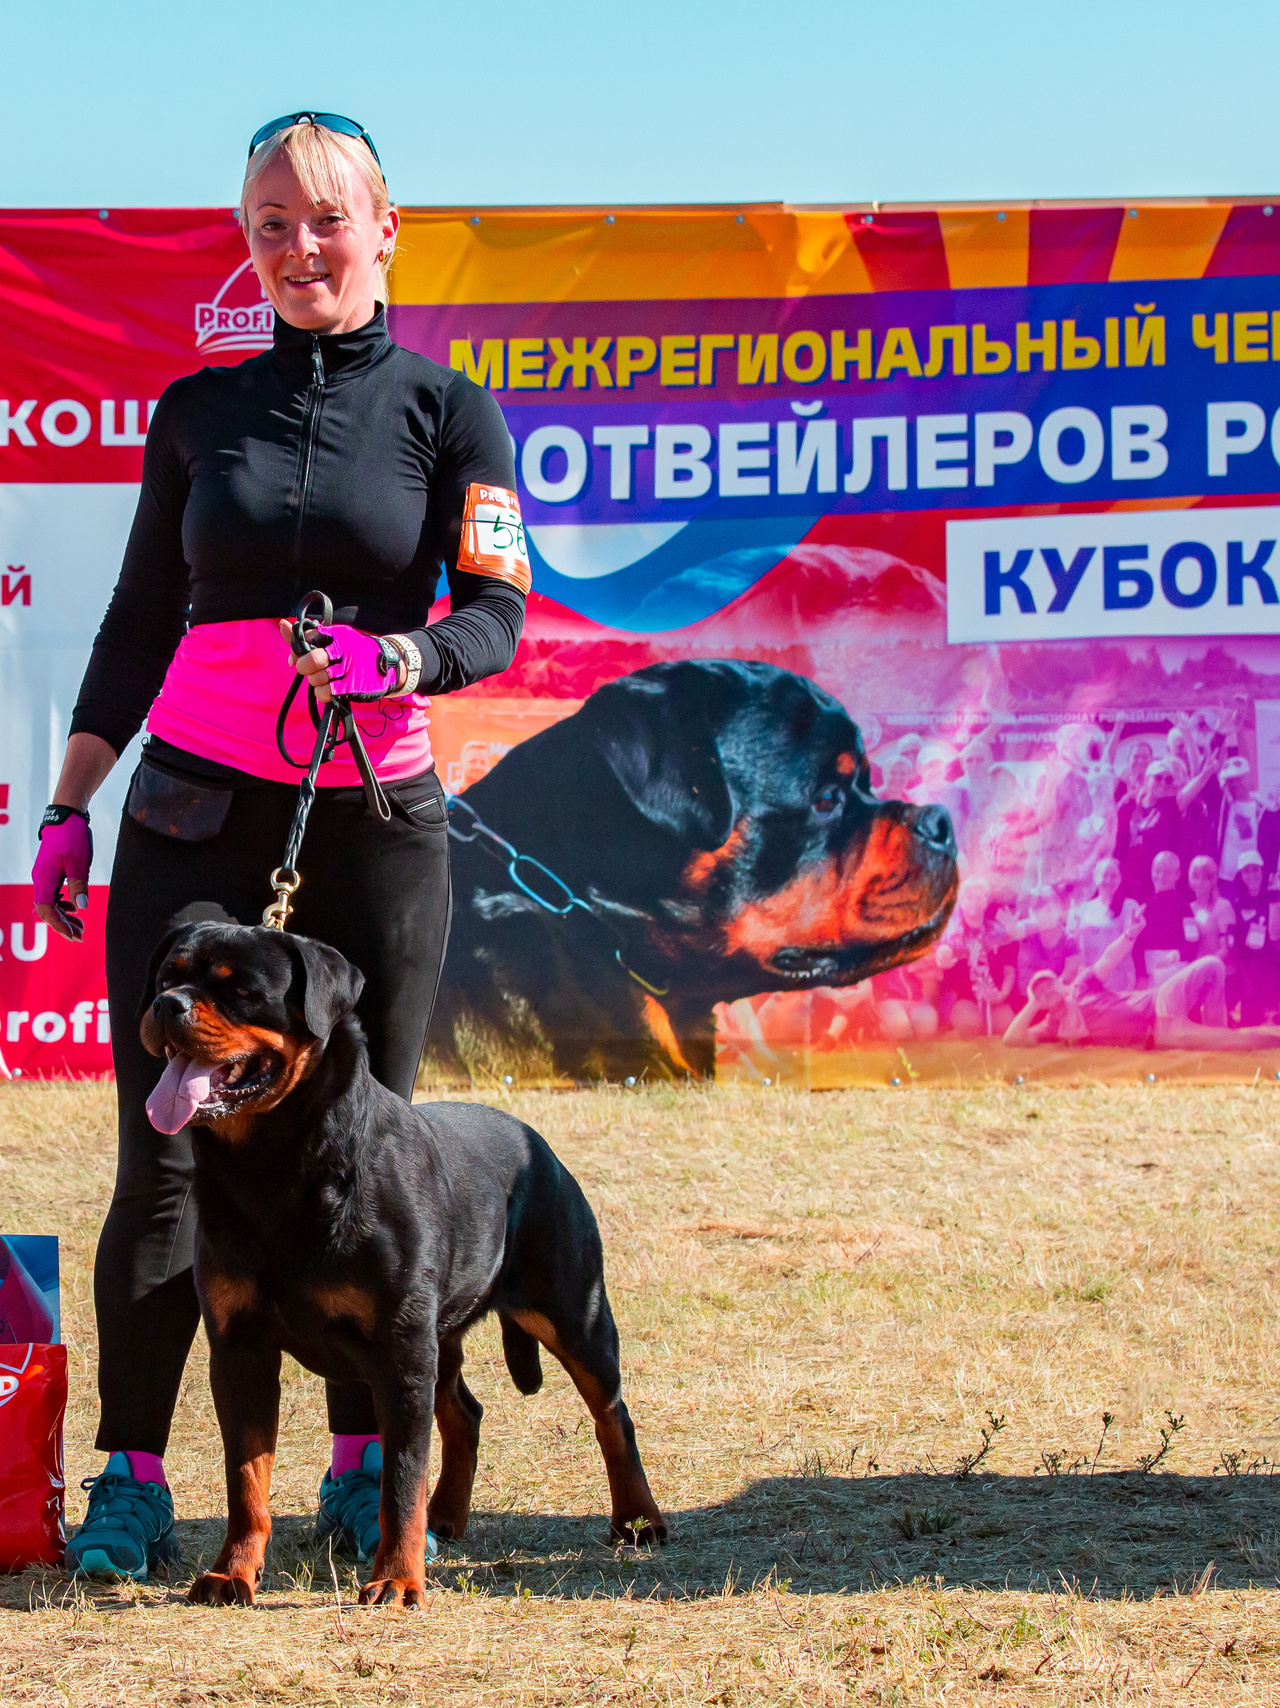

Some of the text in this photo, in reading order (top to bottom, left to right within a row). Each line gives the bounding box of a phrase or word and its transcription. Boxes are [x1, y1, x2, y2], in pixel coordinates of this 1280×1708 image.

[195, 302, 276, 333] PROFI
[449, 302, 1167, 390] МЕЖРЕГИОНАЛЬНЫЙ
[513, 400, 1280, 504] ОТВЕЙЛЕРОВ Р
[983, 539, 1280, 617] КУБОК
